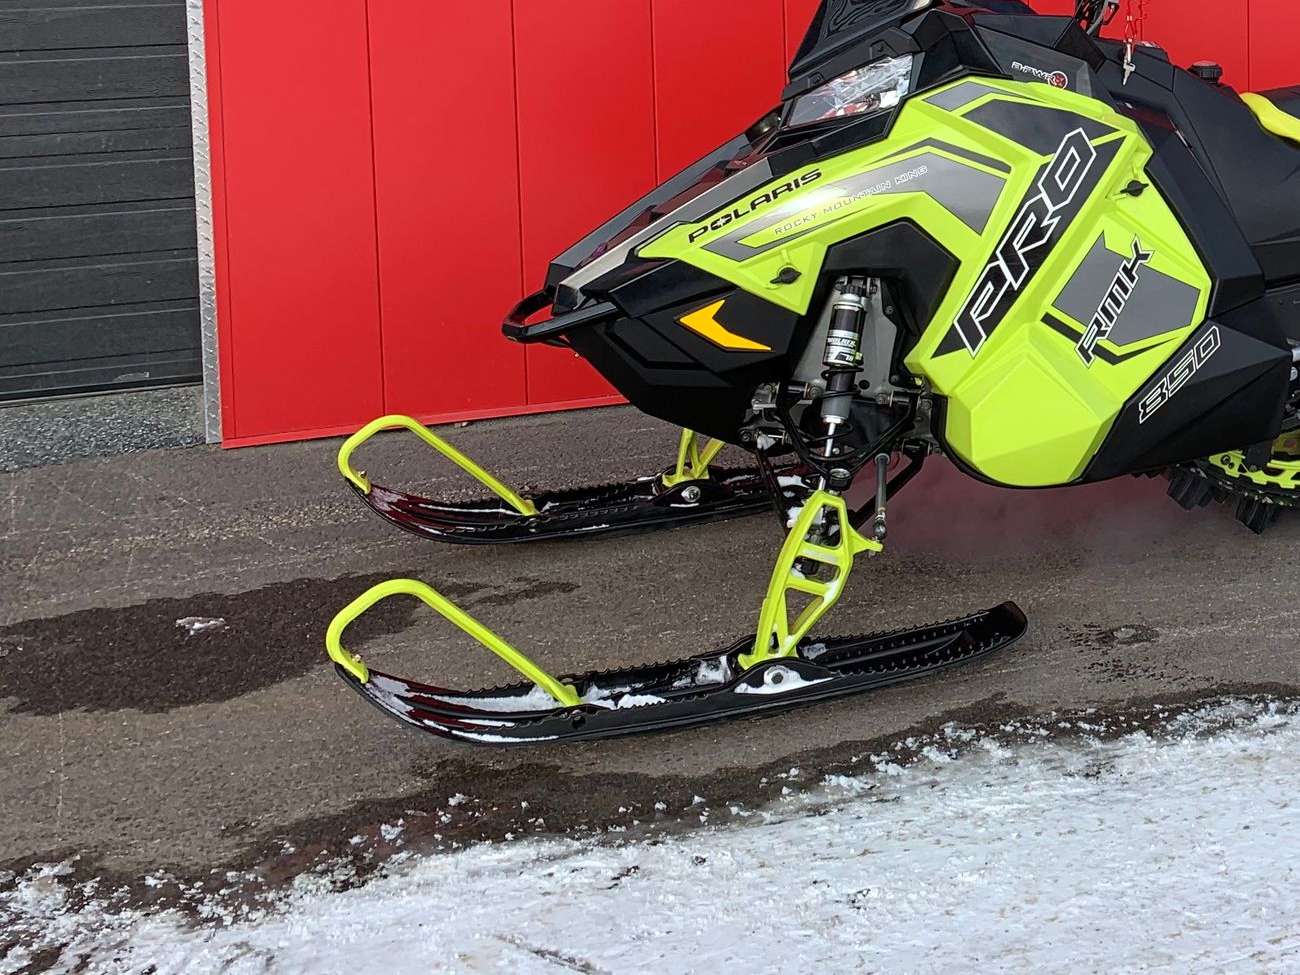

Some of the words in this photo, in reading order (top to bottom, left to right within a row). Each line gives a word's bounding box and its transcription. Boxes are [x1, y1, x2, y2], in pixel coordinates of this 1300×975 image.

[687, 168, 823, 244] POLARIS
[774, 212, 818, 235] ROCKY
[823, 180, 892, 213] MOUNTAIN
[894, 164, 928, 185] KING
[953, 127, 1097, 359] PRO
[1074, 234, 1155, 369] RMK
[1138, 325, 1221, 424] 850
